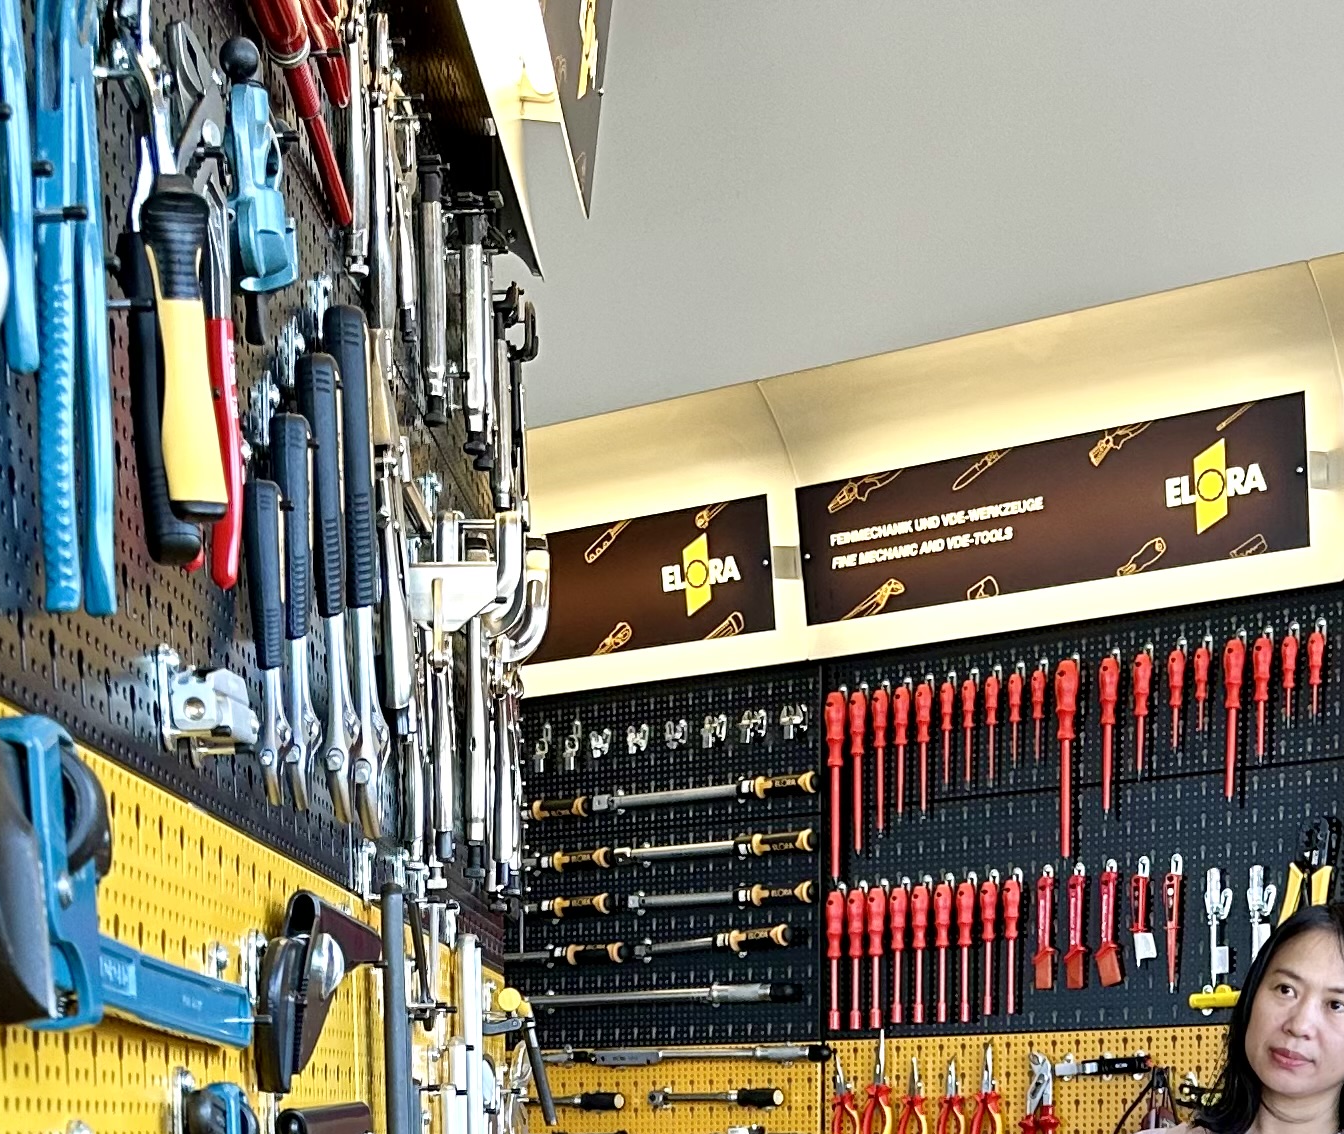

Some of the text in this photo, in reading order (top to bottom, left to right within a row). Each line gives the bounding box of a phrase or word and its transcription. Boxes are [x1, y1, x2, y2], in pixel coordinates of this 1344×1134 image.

[1165, 463, 1268, 508] ELORA
[830, 496, 1044, 547] FEINMECHANIK UND VDE-WERKZEUGE
[831, 526, 1014, 570] FINE MECHANIC AND VDE-TOOLS
[661, 555, 741, 593] ELORA
